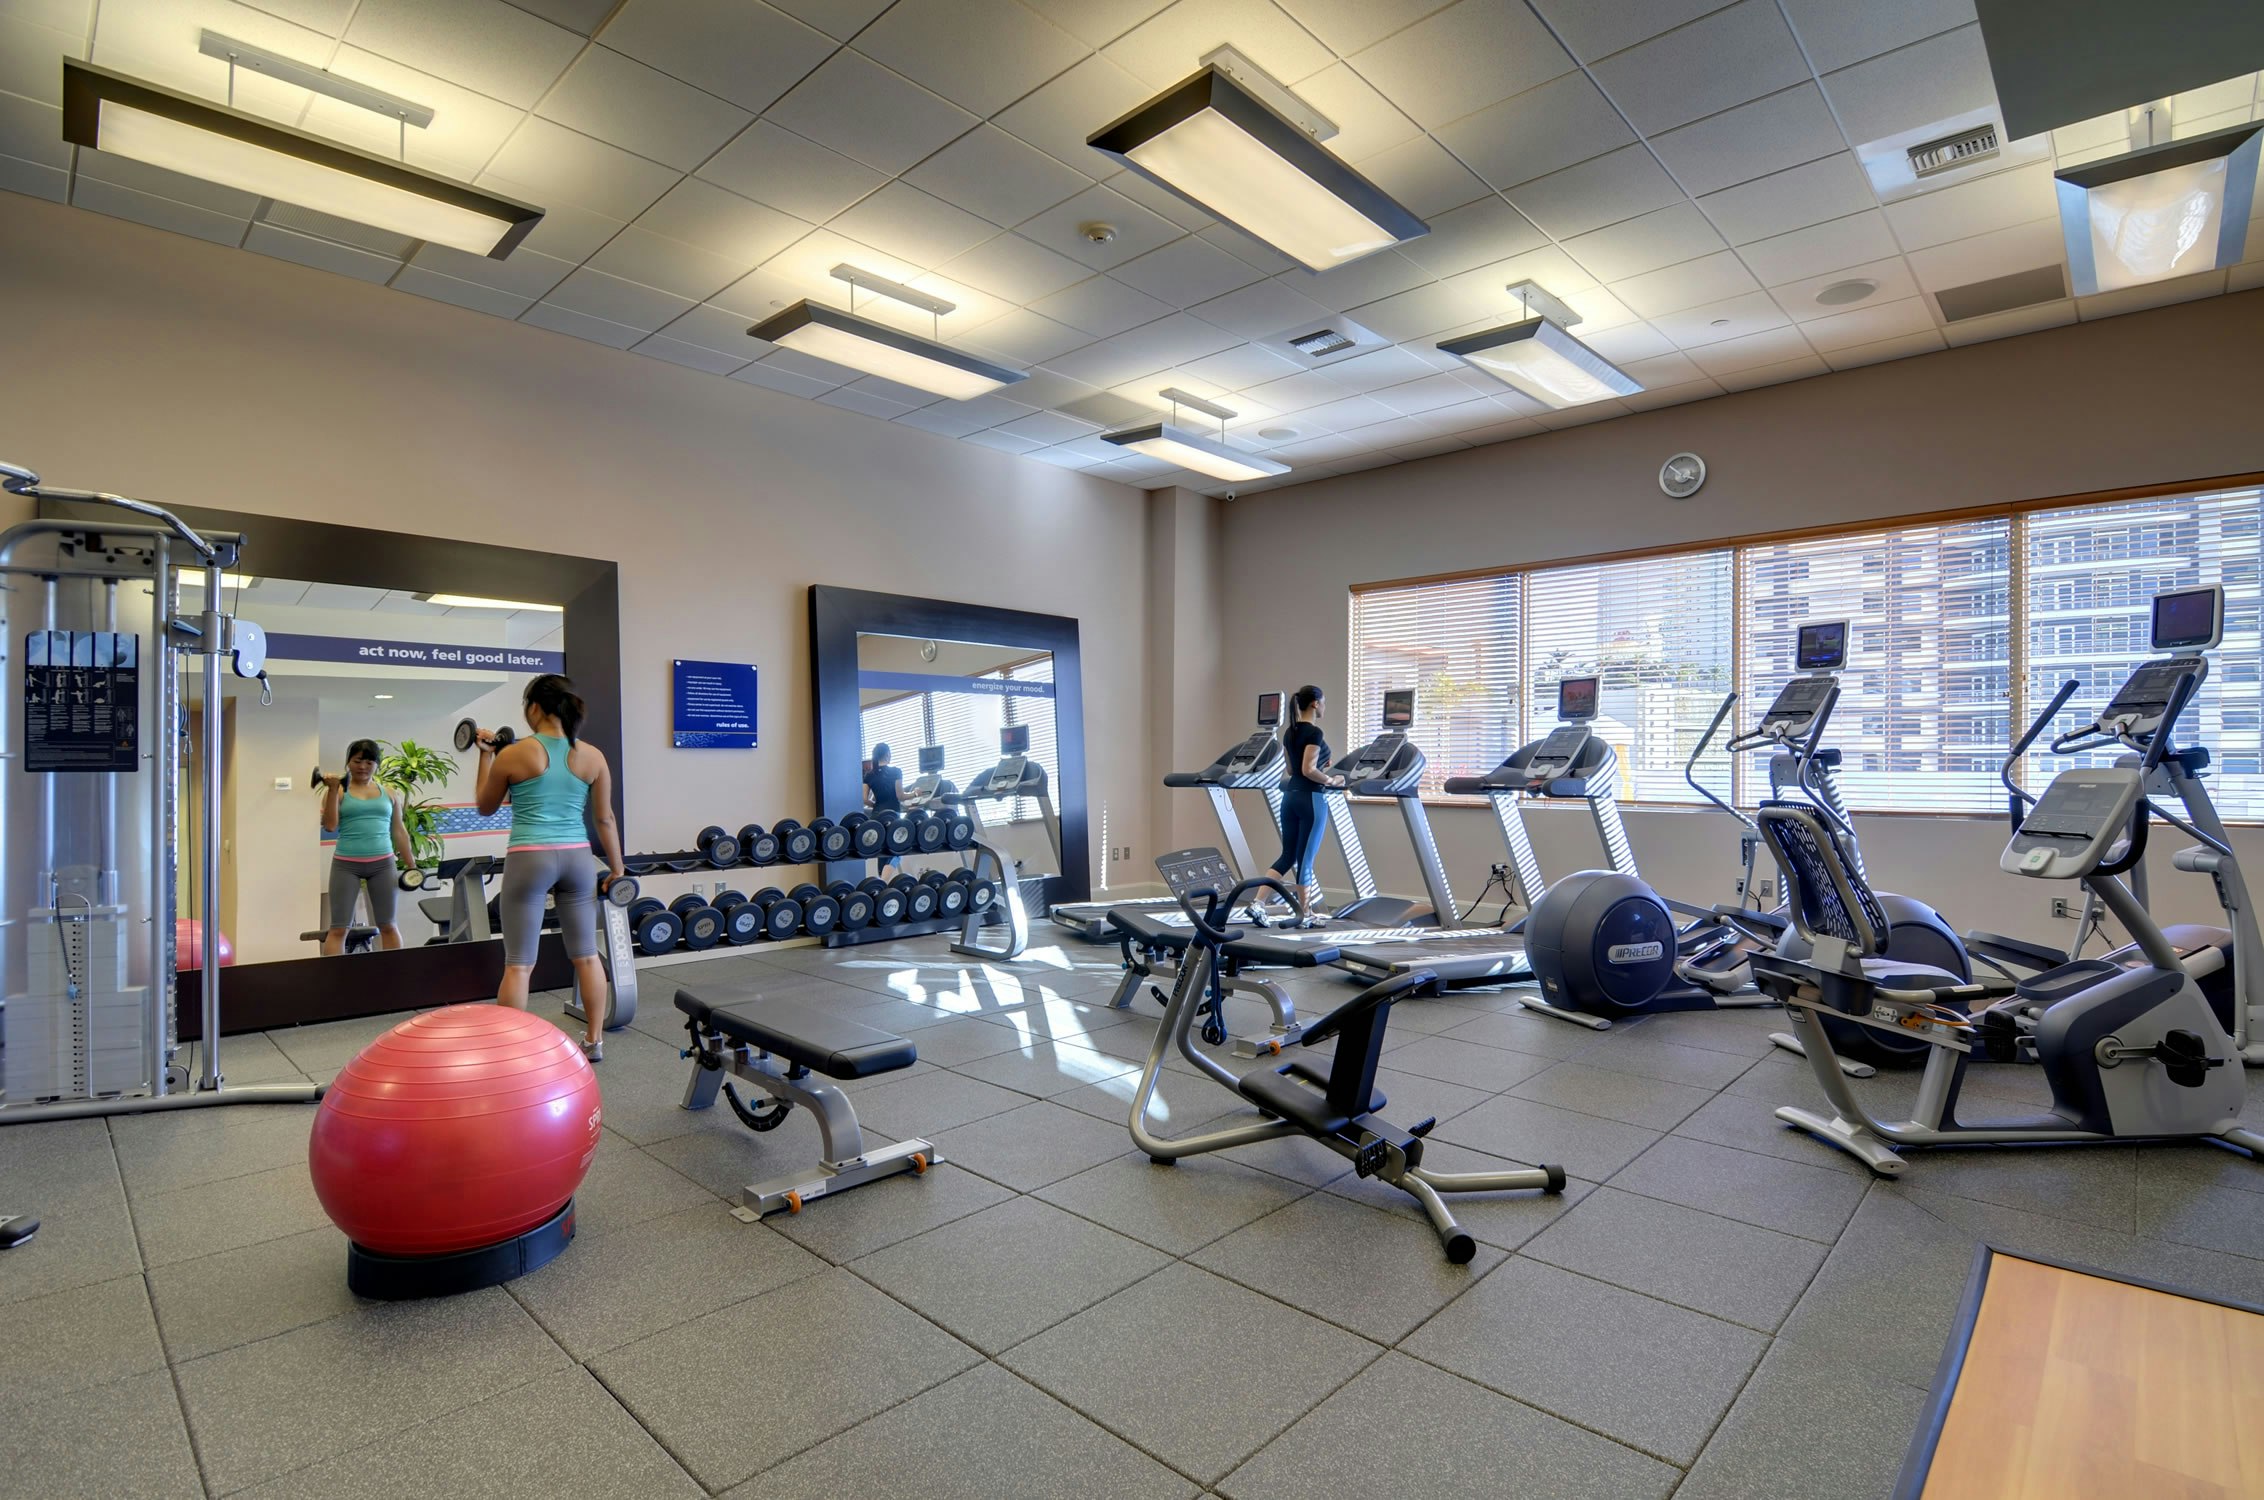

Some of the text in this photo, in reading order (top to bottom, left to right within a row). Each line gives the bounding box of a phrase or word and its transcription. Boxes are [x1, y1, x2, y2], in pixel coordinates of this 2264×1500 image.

[359, 646, 544, 666] act now, feel good later.
[972, 682, 1045, 693] energize your mood.
[1622, 945, 1659, 958] PRECOR
